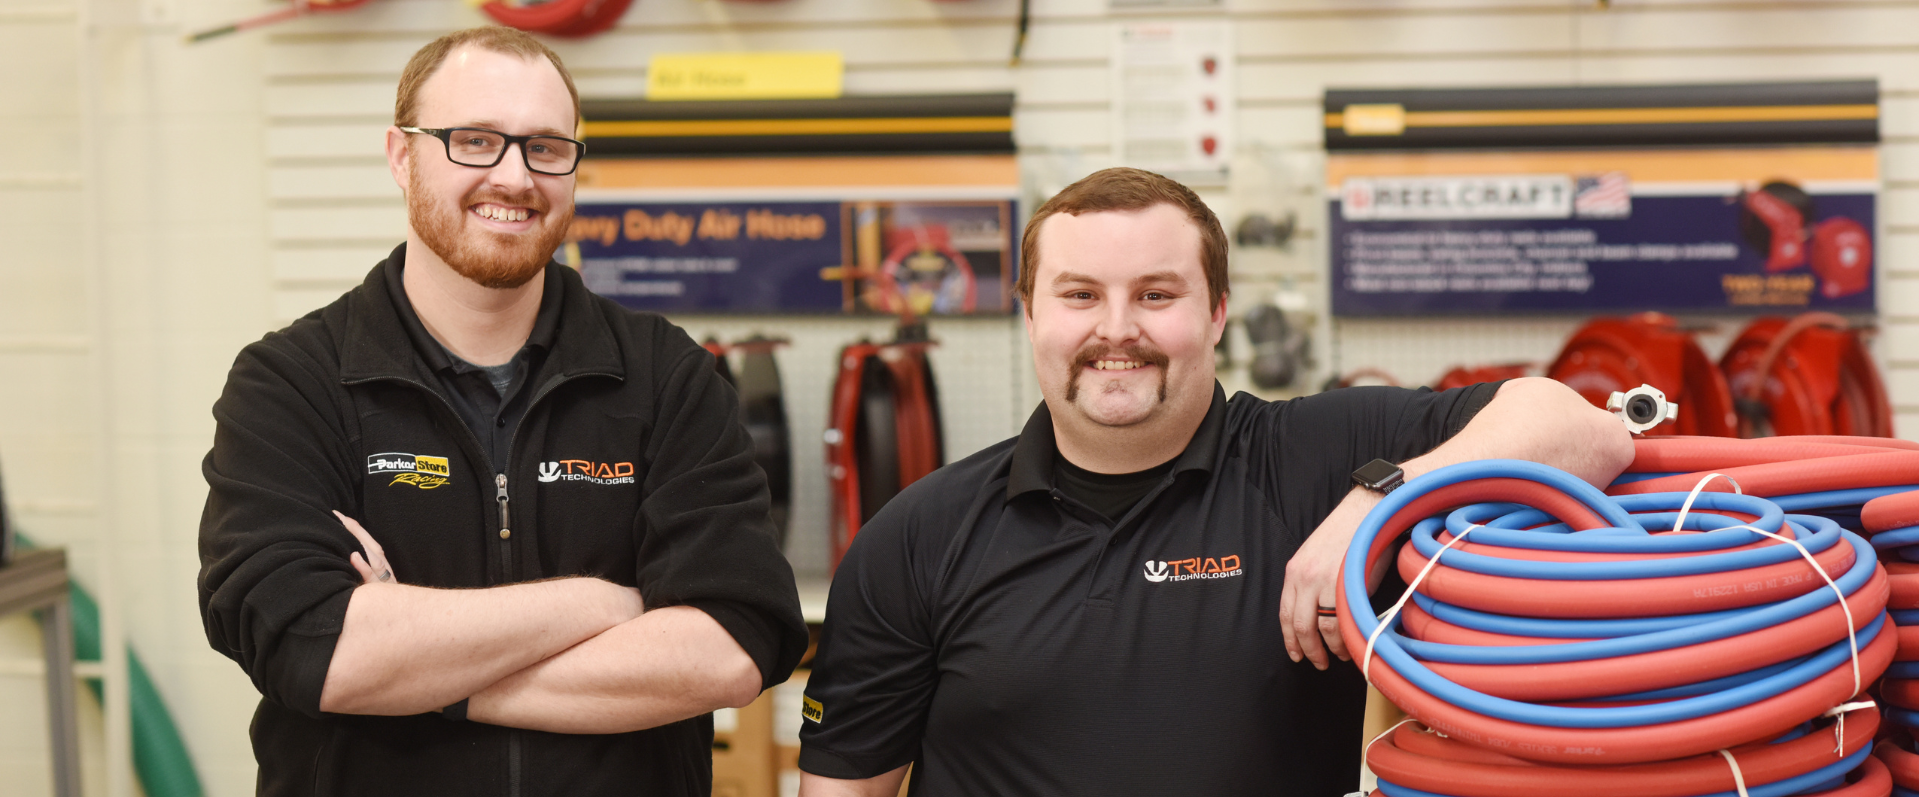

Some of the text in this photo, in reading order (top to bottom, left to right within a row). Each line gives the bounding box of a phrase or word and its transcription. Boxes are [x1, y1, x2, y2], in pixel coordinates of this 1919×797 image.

[1373, 183, 1563, 207] REELCRAFT
[623, 210, 694, 245] Duty
[697, 210, 742, 240] Air
[746, 210, 826, 240] Hose
[560, 459, 634, 478] TRIAD
[388, 472, 450, 489] Racing
[561, 473, 635, 485] TECHNOLOGIES
[1168, 554, 1241, 576] TRIAD
[1168, 568, 1243, 582] TECHNOLOGIES
